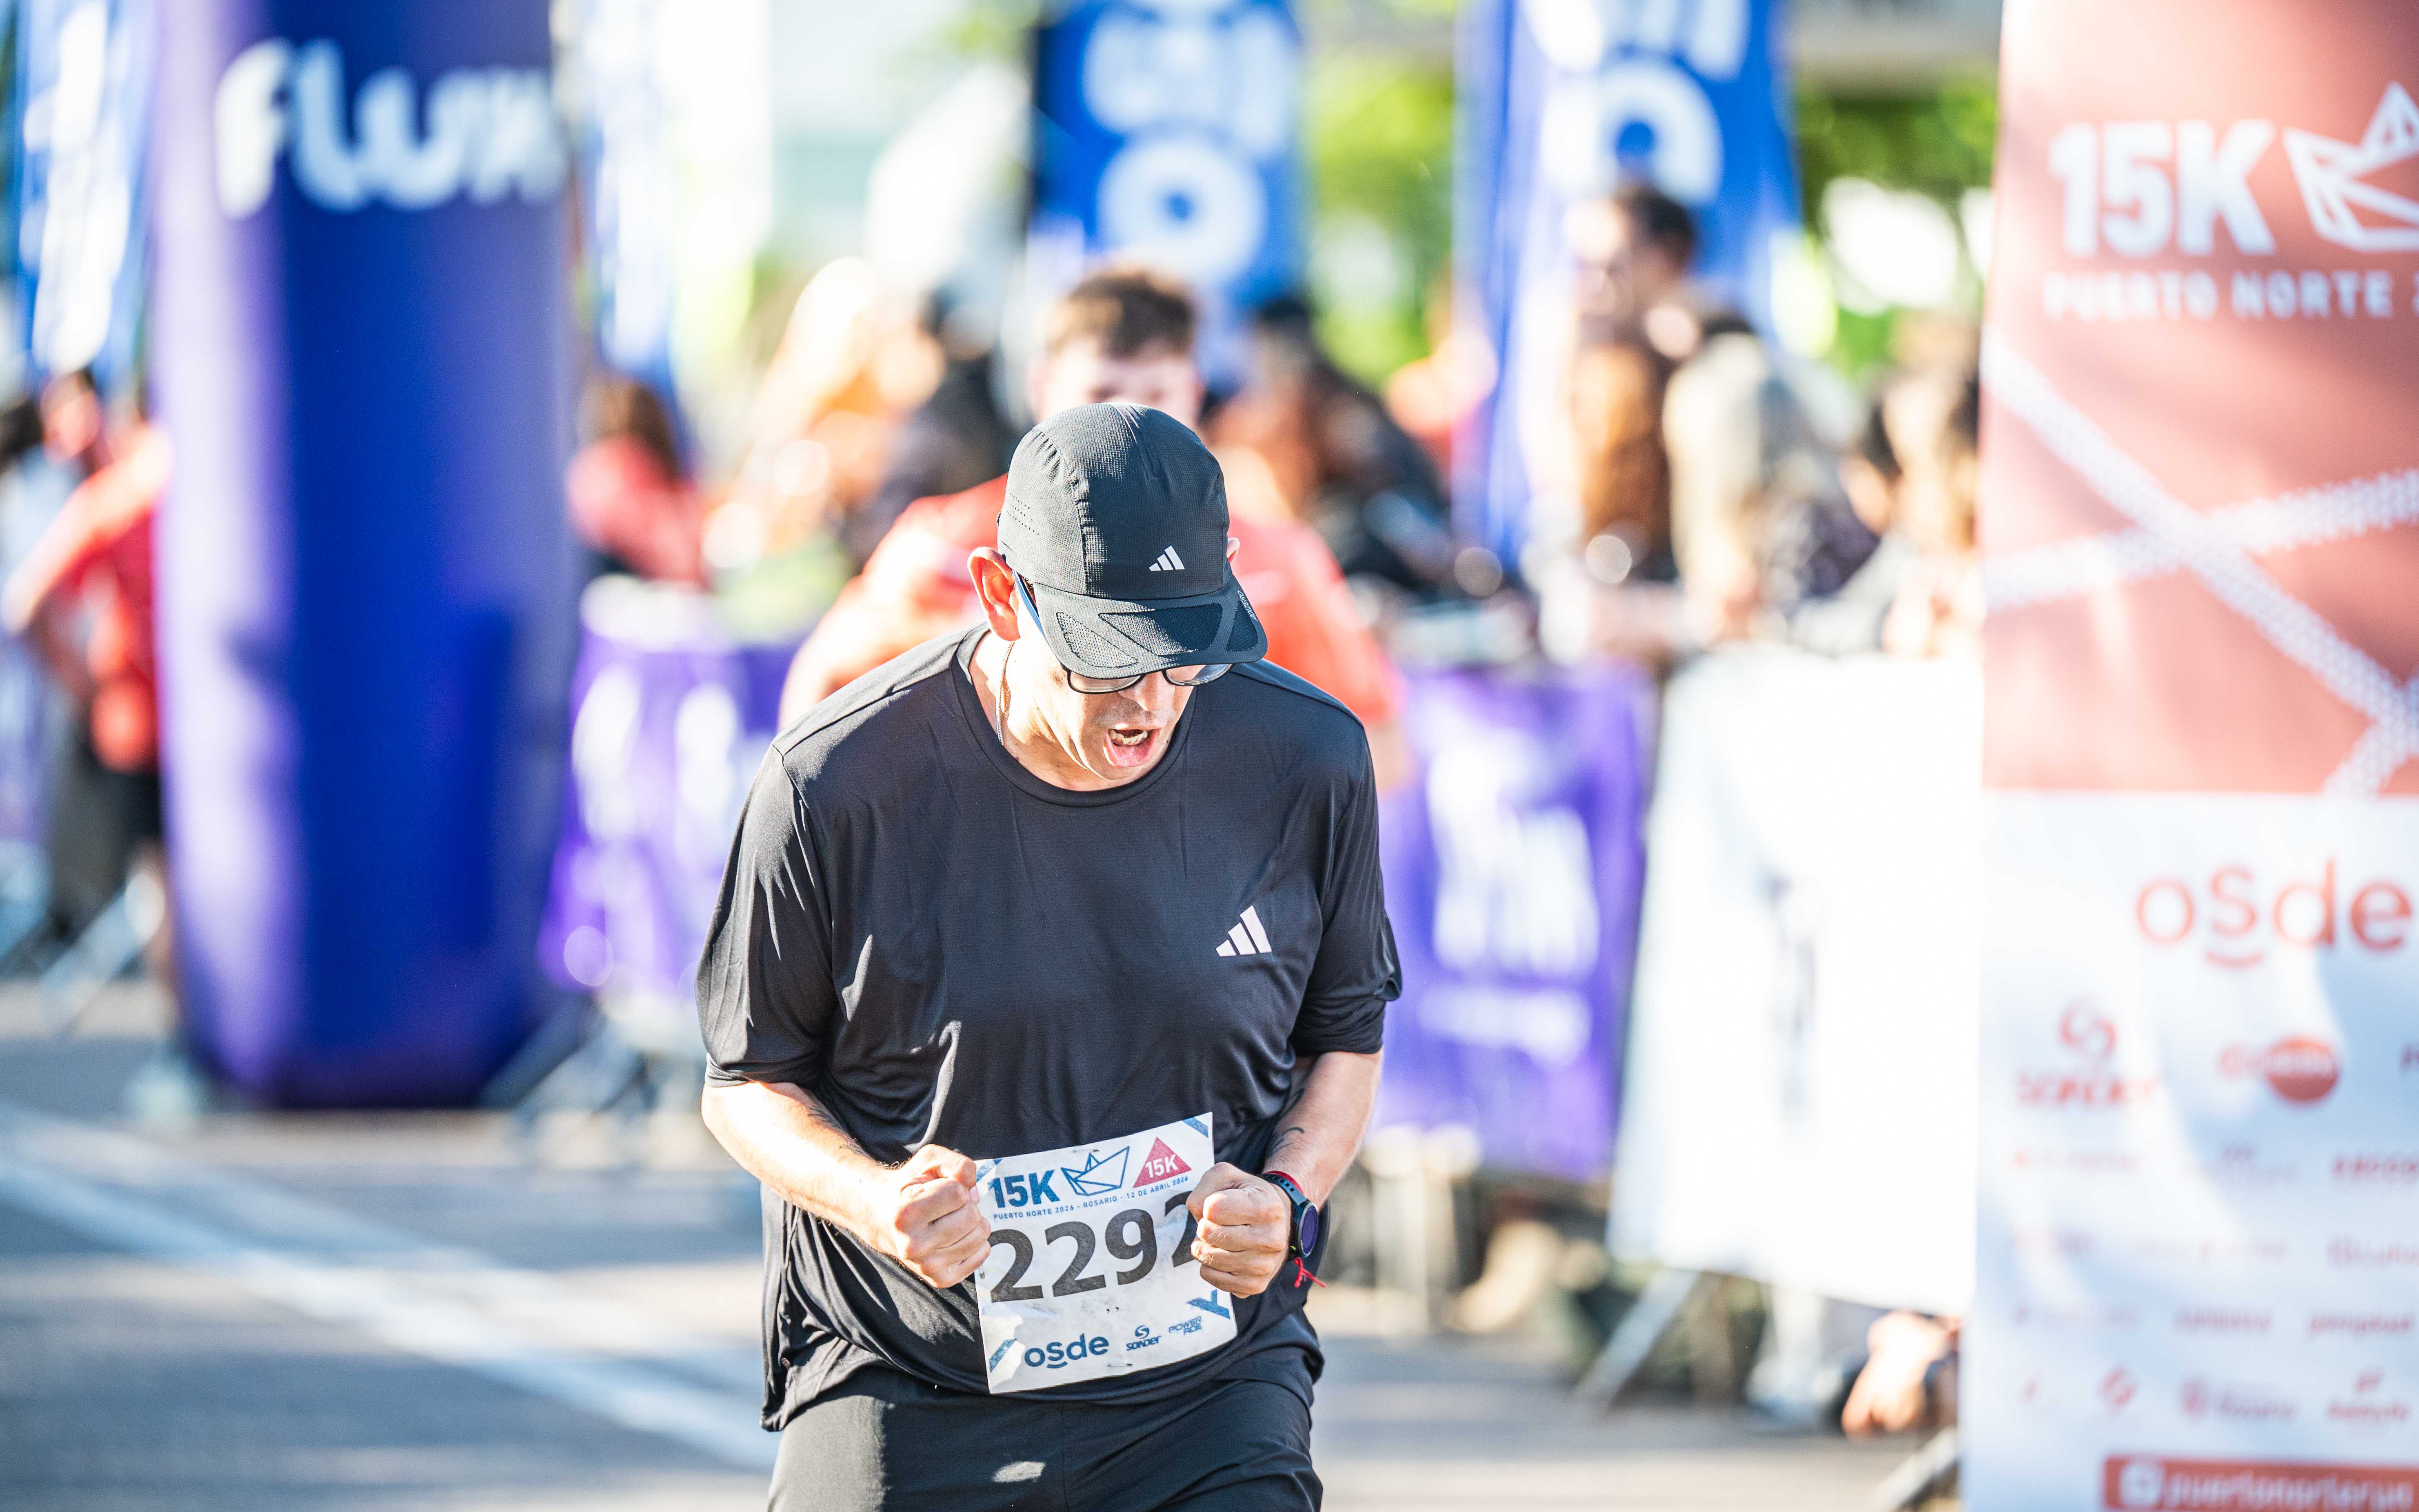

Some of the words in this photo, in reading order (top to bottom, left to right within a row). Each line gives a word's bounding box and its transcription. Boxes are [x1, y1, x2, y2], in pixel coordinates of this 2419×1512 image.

[2048, 120, 2275, 258] 15K
[2044, 271, 2218, 322] PUERTO
[2231, 270, 2392, 318] NORTE
[1237, 590, 1258, 622] ADIZERO
[2135, 855, 2413, 968] osde
[1145, 1154, 1179, 1178] 15K
[987, 1169, 1060, 1208] 15K
[1026, 1208, 1052, 1217] NORTE
[1055, 1205, 1074, 1213] 2026
[1083, 1196, 1117, 1208] ROSARIO
[1150, 1183, 1170, 1193] ABRIL
[1173, 1175, 1188, 1186] 2026
[1168, 1316, 1202, 1333] POWER
[1024, 1333, 1109, 1368] osde
